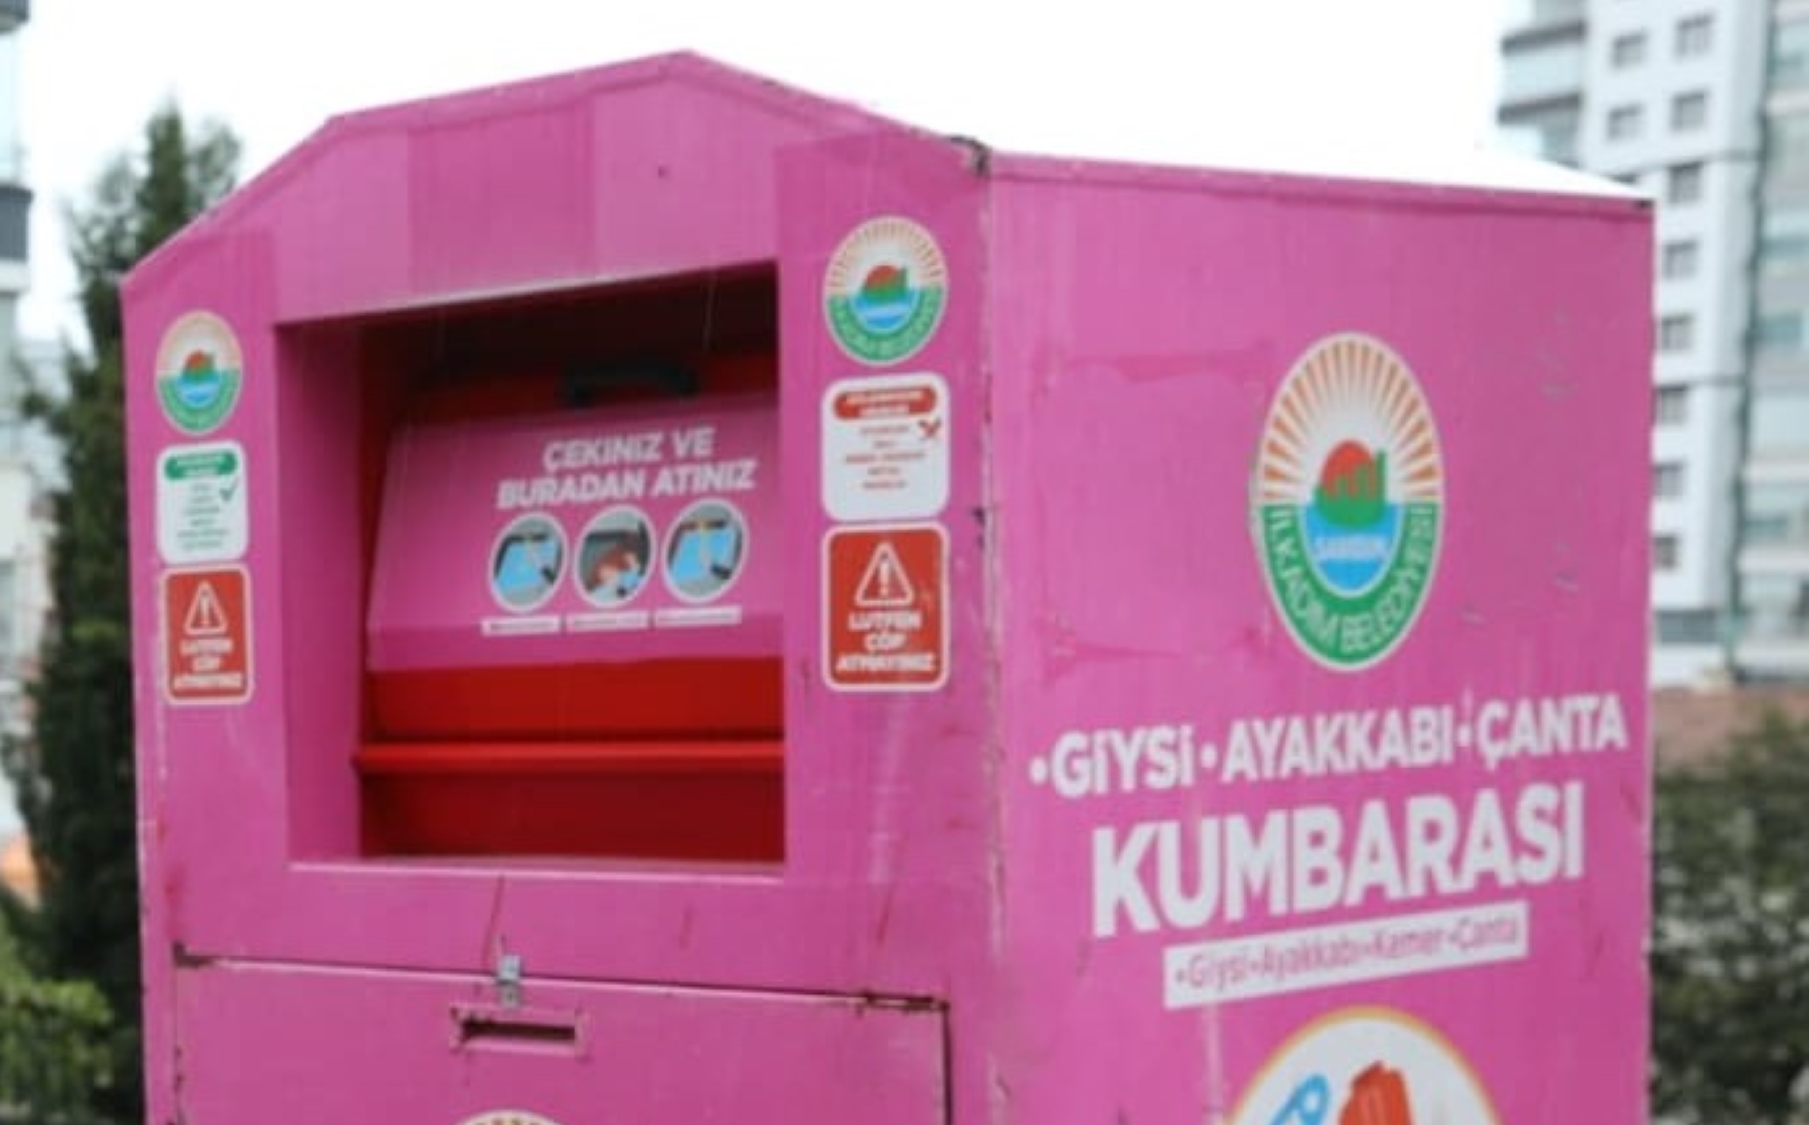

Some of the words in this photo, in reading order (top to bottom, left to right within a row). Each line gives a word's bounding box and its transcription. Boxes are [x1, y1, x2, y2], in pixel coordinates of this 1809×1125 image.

[671, 427, 715, 457] VE
[497, 469, 645, 509] BURADAN
[653, 459, 758, 498] ATINIZ
[1222, 705, 1453, 782] AYAKKABI
[1476, 694, 1629, 771] ÇANTA
[1093, 782, 1585, 938] KUMBARASI
